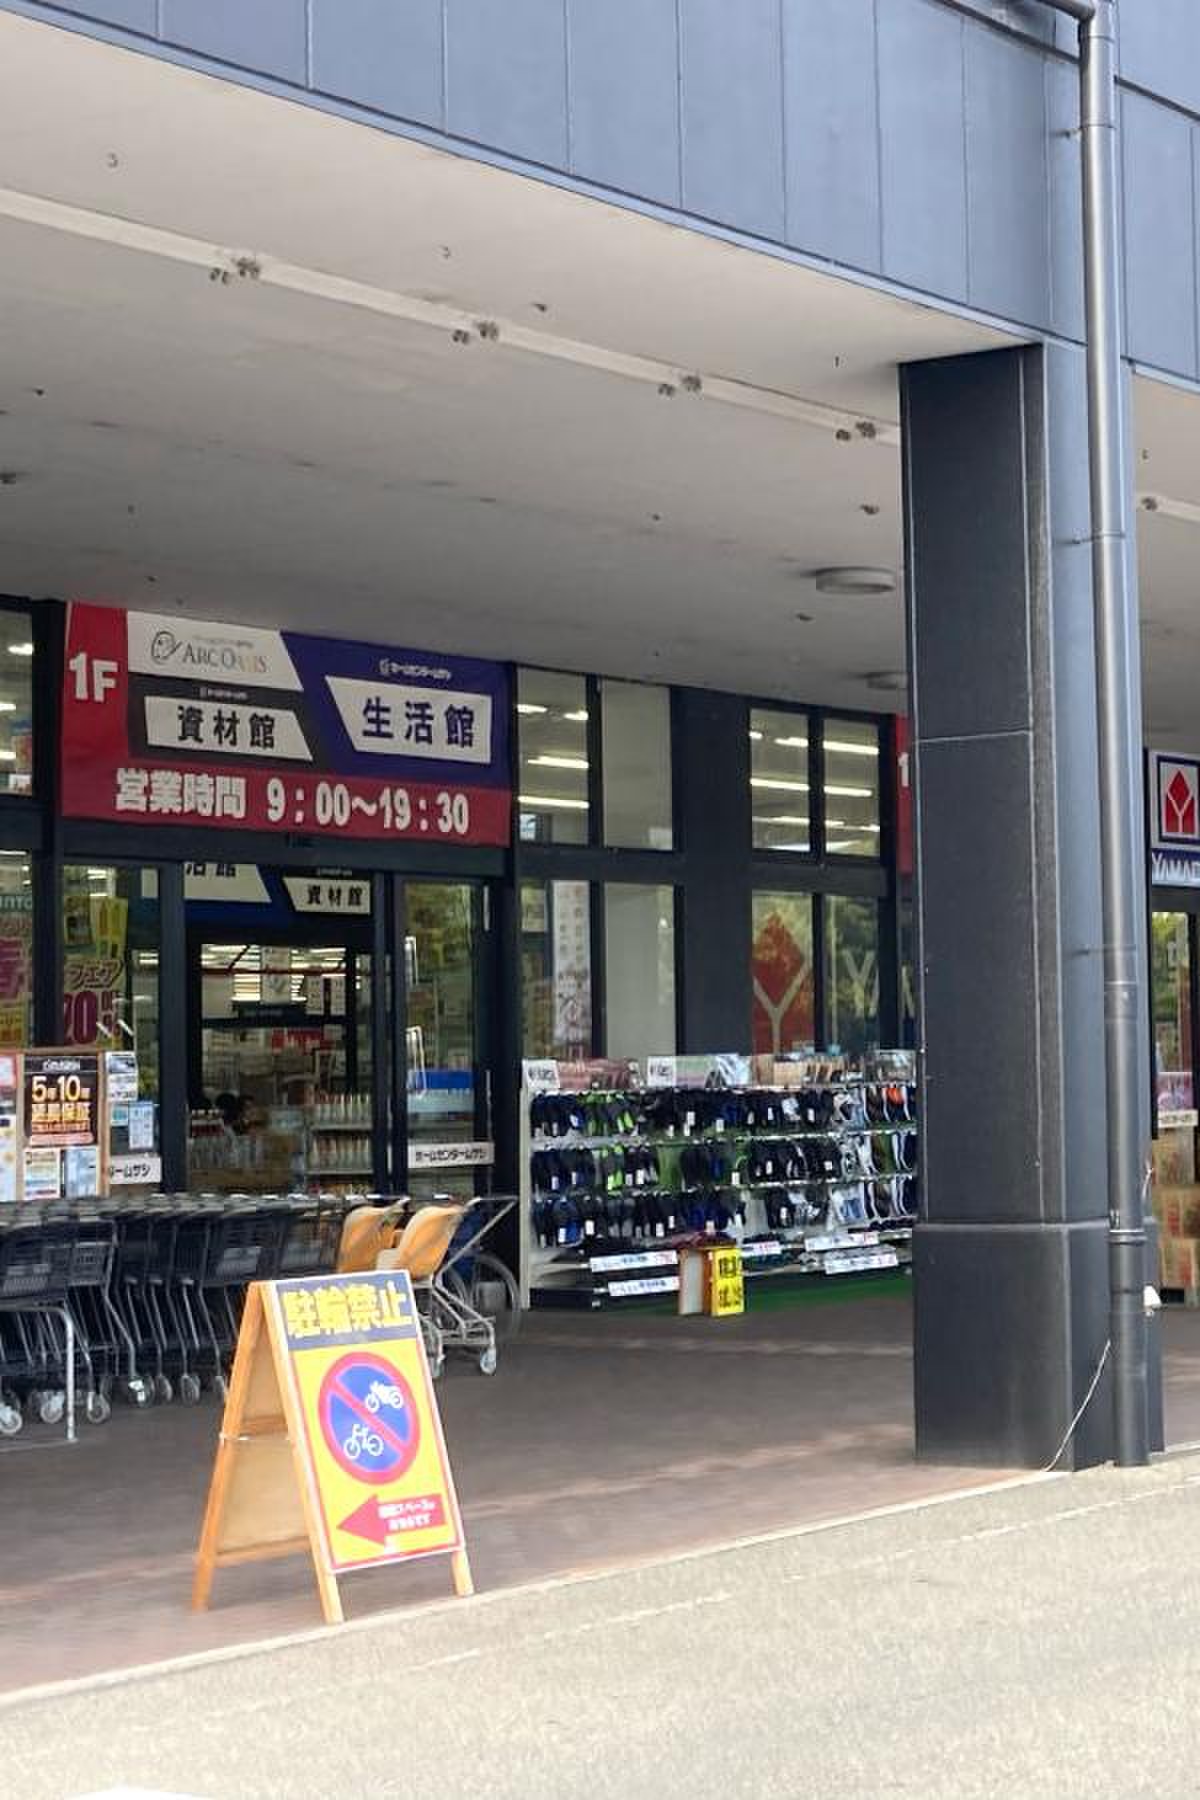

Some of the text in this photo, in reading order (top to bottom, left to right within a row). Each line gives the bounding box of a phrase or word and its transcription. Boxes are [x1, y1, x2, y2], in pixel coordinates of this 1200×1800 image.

[69, 652, 118, 702] 1F
[178, 705, 275, 748] 資材館
[362, 696, 475, 748] 生活館
[116, 767, 246, 819] 営業時間
